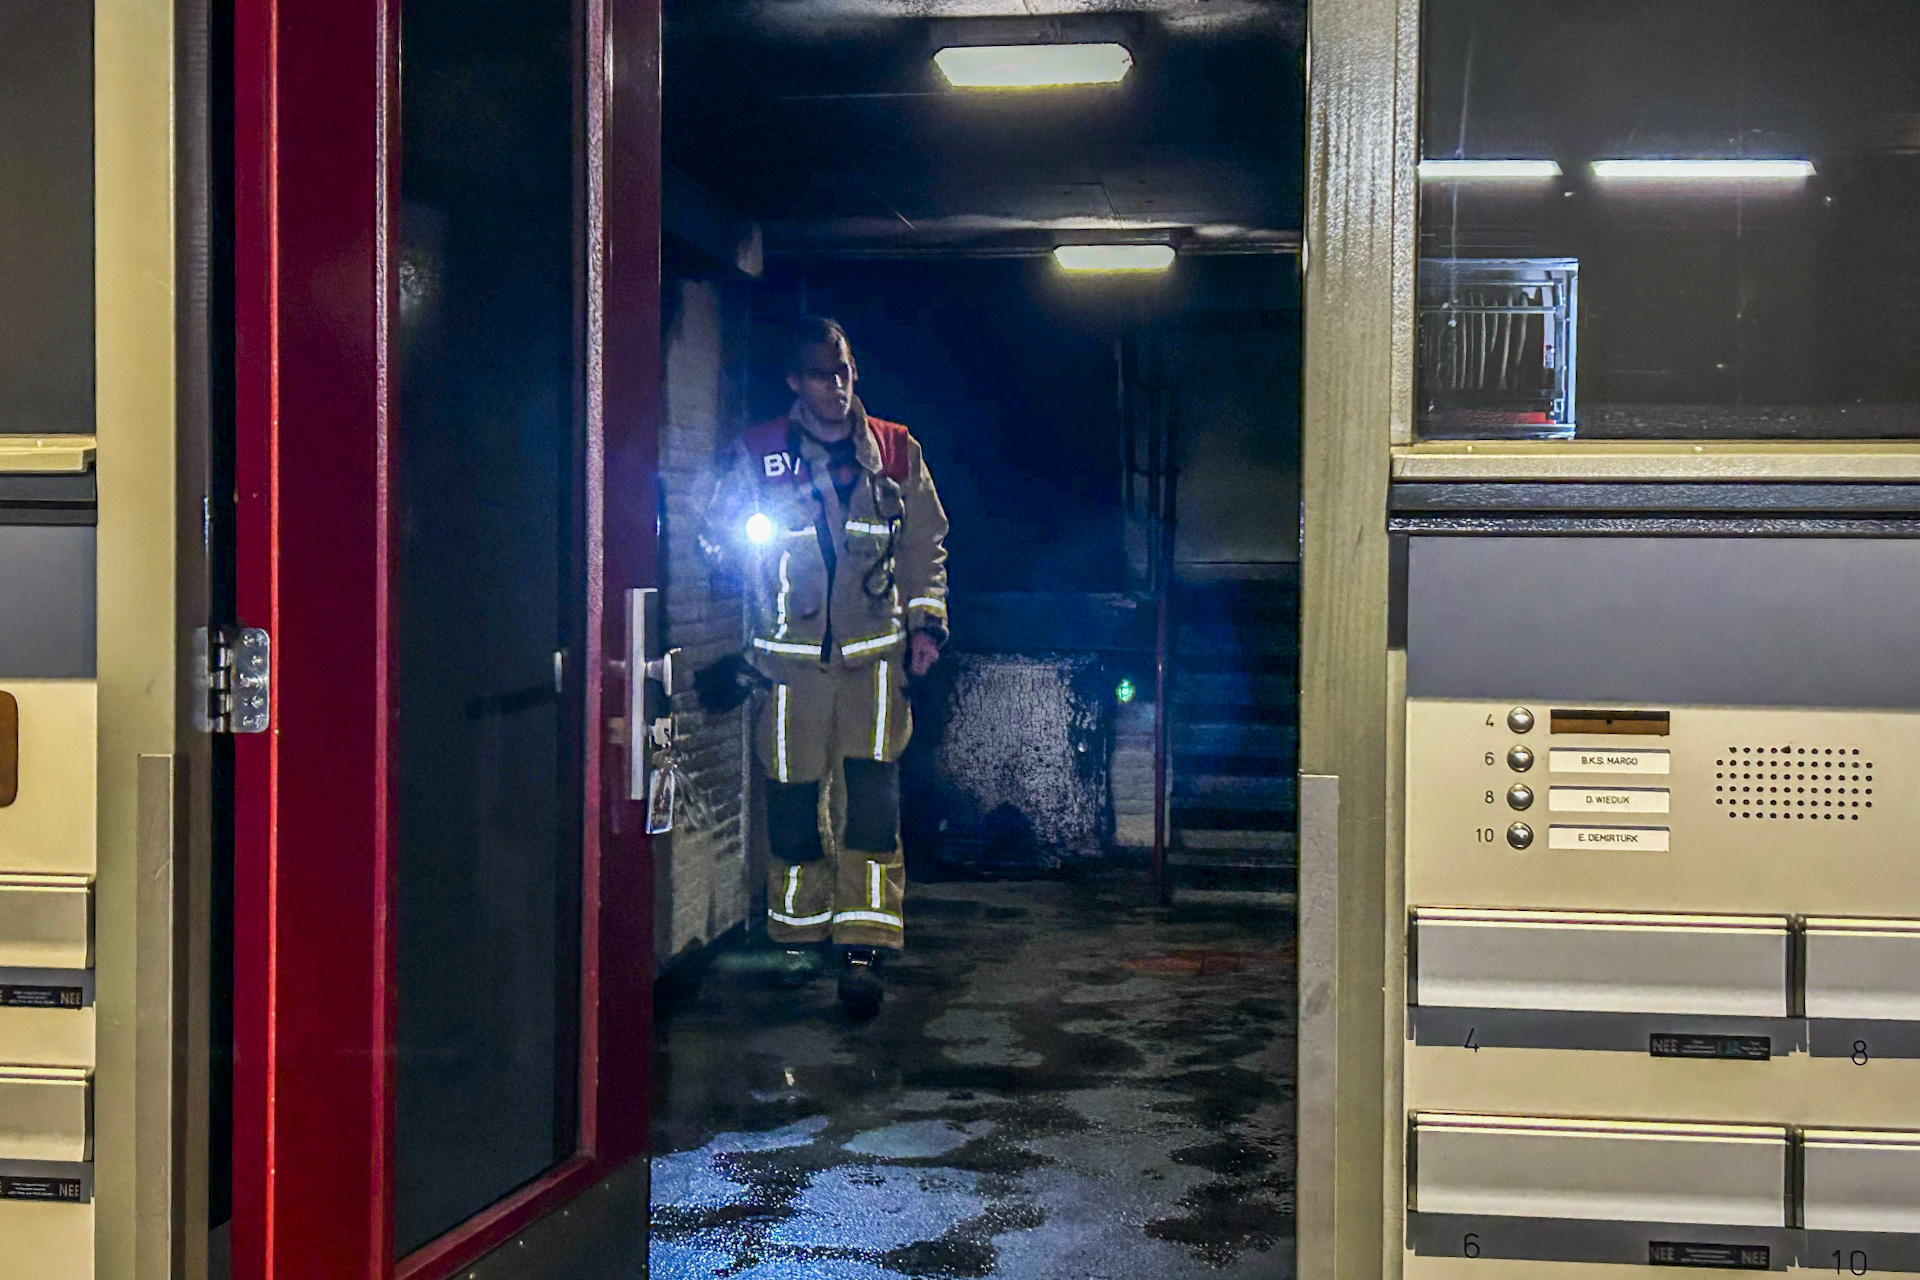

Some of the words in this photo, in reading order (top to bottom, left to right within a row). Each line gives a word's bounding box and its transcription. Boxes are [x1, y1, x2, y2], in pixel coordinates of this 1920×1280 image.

[1485, 714, 1495, 727] 4
[1484, 751, 1495, 766] 6
[1607, 757, 1638, 765] MARGO
[1484, 790, 1495, 804] 8
[1475, 828, 1495, 842] 10
[60, 992, 82, 1005] NEE
[1463, 1027, 1479, 1053] 4
[1653, 1038, 1678, 1054] NEE
[1851, 1040, 1870, 1066] 8
[58, 1183, 80, 1197] NEE
[1463, 1232, 1481, 1259] 6
[1650, 1245, 1676, 1261] NEE
[1740, 1249, 1768, 1266] NEE
[1831, 1249, 1868, 1276] 10
